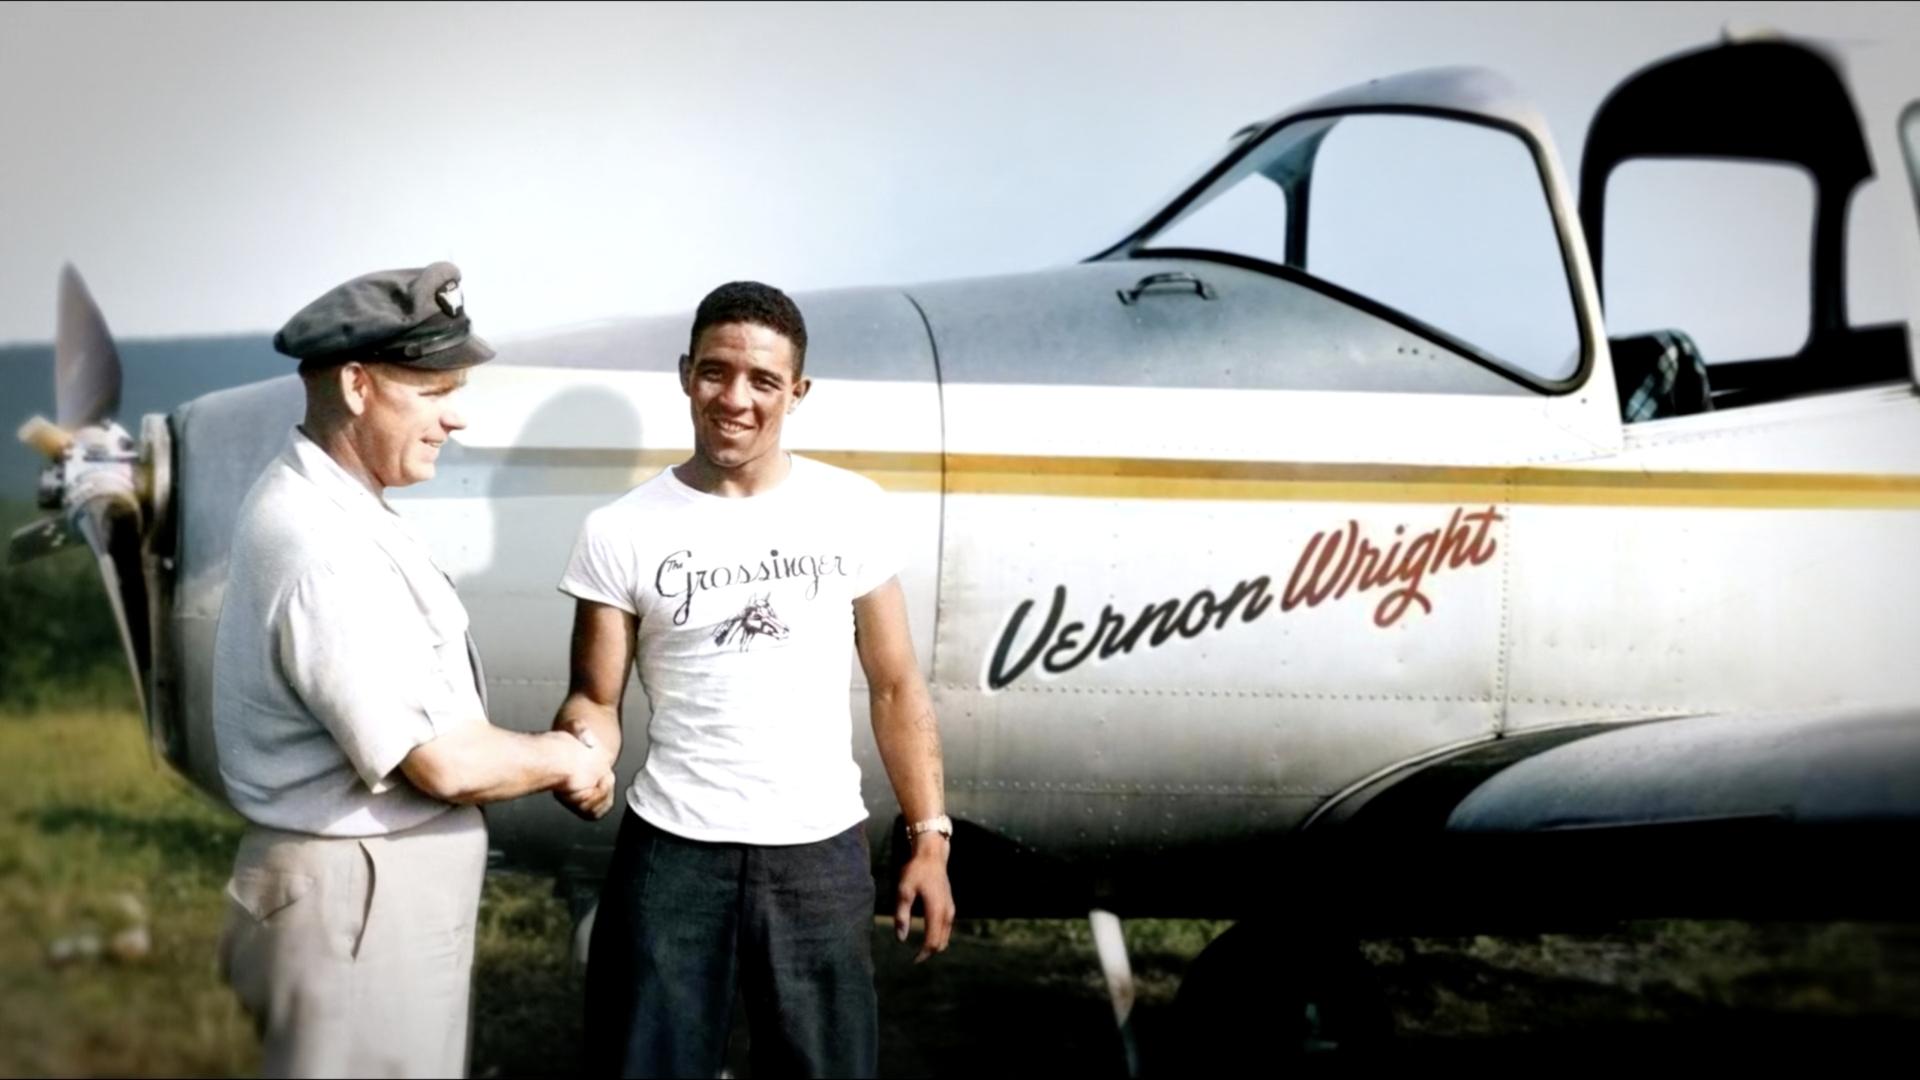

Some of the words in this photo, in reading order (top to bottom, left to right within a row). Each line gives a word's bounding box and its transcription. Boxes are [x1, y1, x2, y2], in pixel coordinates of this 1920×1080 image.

[655, 549, 847, 626] Grossinger
[666, 559, 685, 572] The
[987, 574, 1273, 690] Vernon
[1281, 505, 1503, 628] Wright
